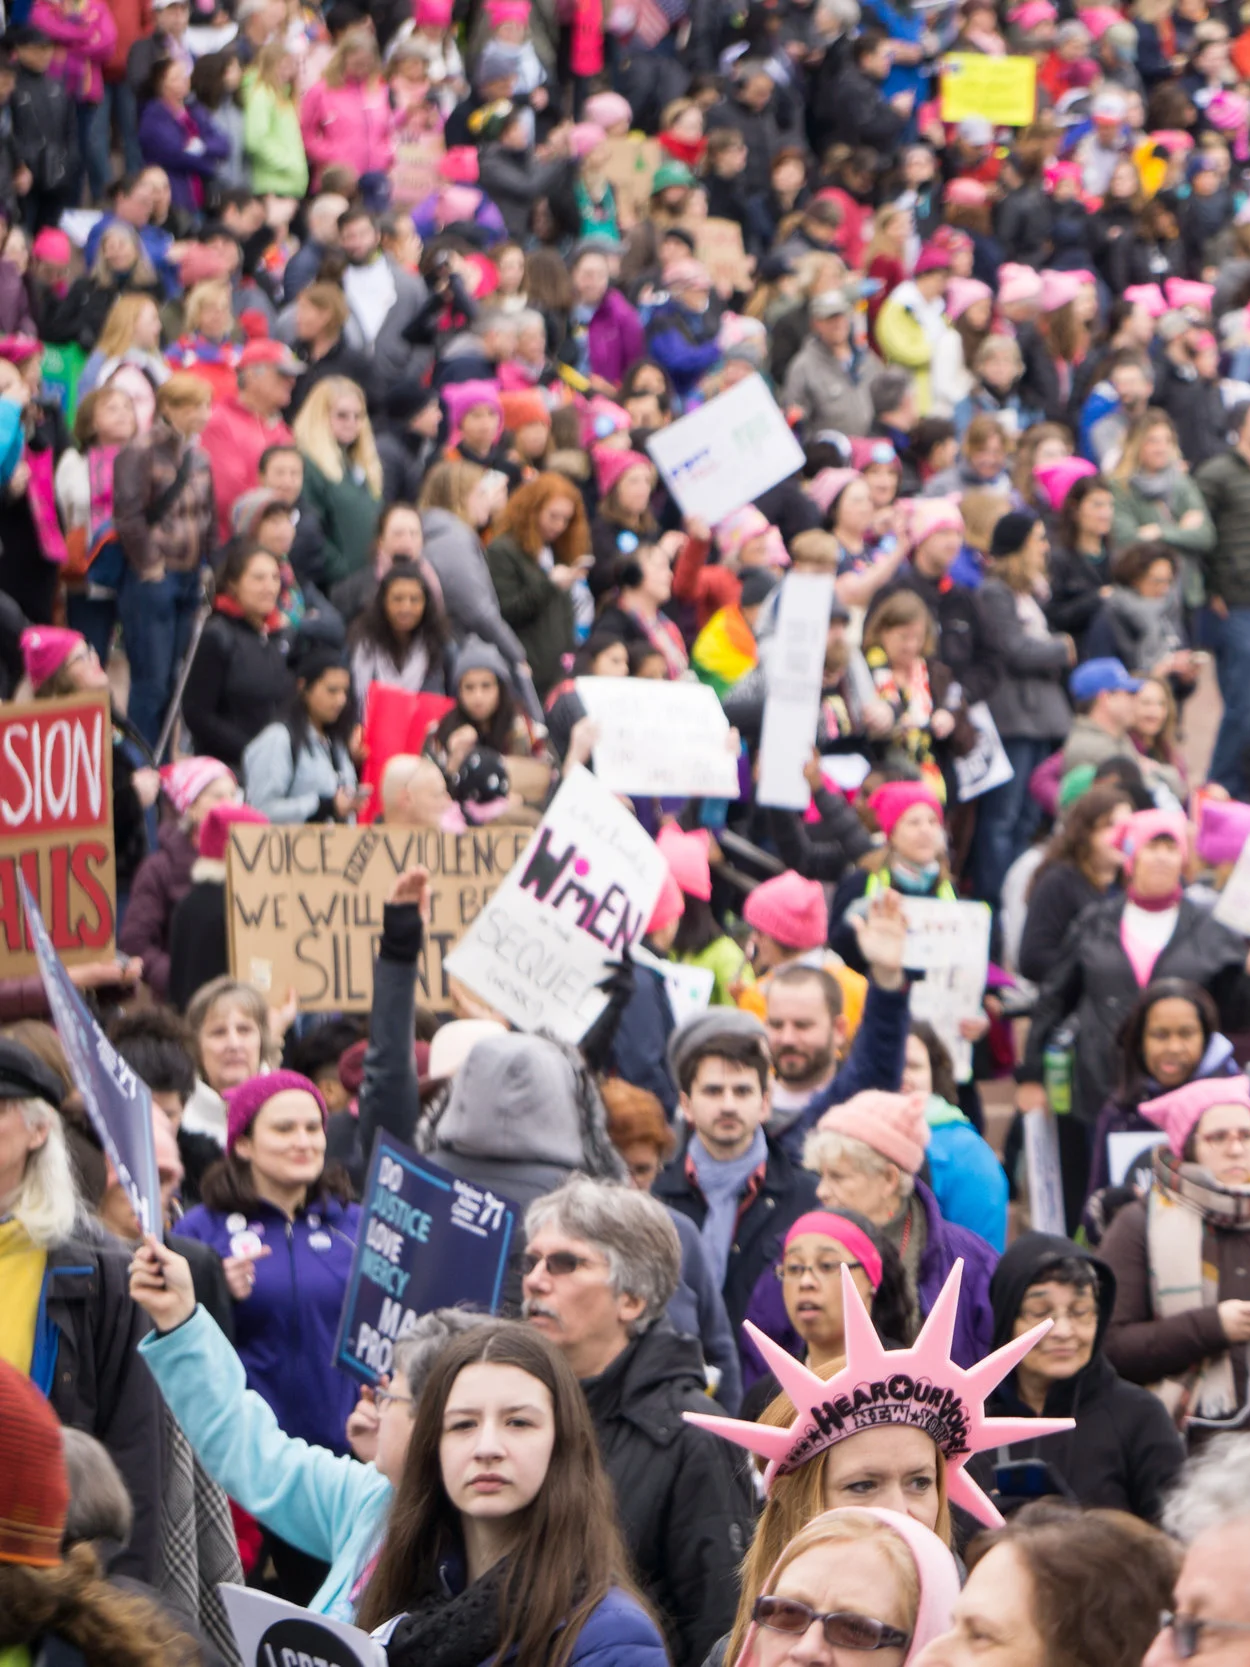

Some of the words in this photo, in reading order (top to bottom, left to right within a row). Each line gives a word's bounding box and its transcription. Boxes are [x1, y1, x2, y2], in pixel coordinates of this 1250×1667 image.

[231, 829, 341, 875] VOICE
[235, 892, 286, 930] WE
[298, 893, 380, 928] WILL
[378, 1156, 403, 1192] DO
[370, 1188, 433, 1244] JUSTICE
[366, 1217, 404, 1264] LOVE
[361, 1247, 411, 1298] MERCY
[810, 1381, 889, 1435] HEAR
[888, 1374, 944, 1408] OUR
[853, 1404, 909, 1429] NEW
